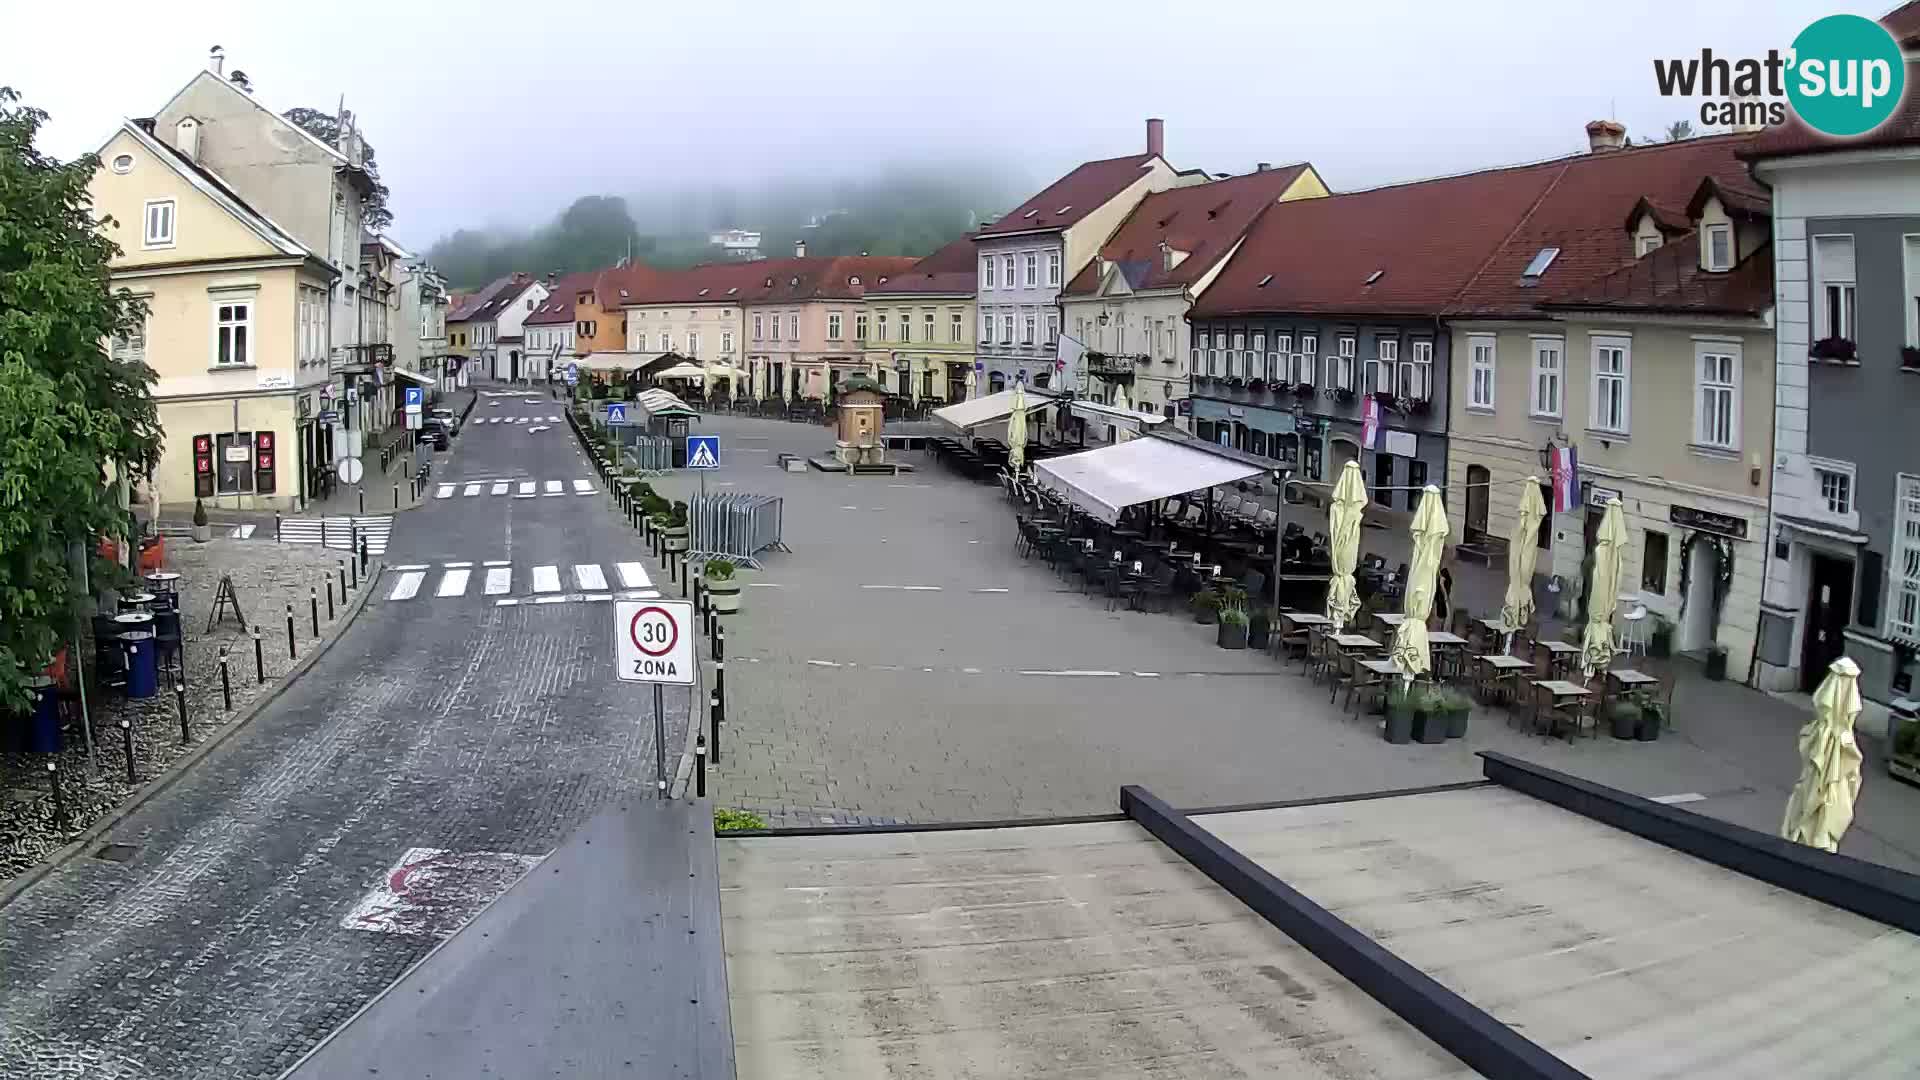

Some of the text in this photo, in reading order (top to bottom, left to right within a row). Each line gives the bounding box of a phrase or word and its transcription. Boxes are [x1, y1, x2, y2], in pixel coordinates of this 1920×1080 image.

[410, 391, 418, 402] P
[643, 622, 667, 643] 30
[633, 660, 677, 676] ZONA
